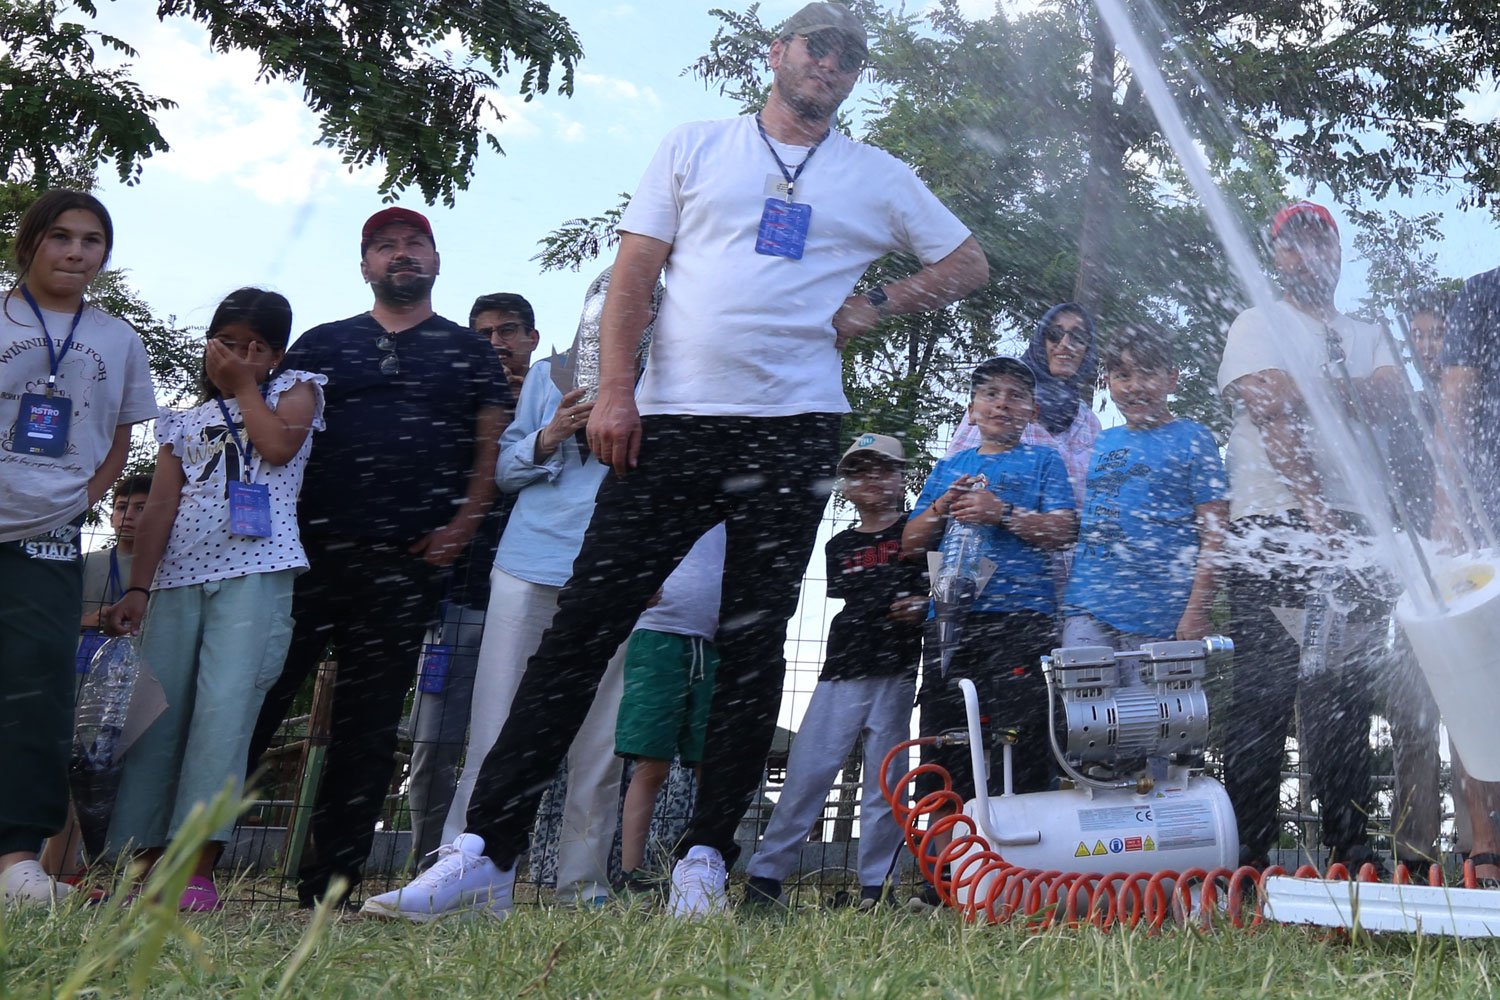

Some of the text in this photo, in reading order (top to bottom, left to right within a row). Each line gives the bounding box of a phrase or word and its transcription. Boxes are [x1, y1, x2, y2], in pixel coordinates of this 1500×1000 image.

[84, 347, 107, 383] POOH
[31, 407, 60, 417] ASTRO
[25, 541, 79, 559] STATE
